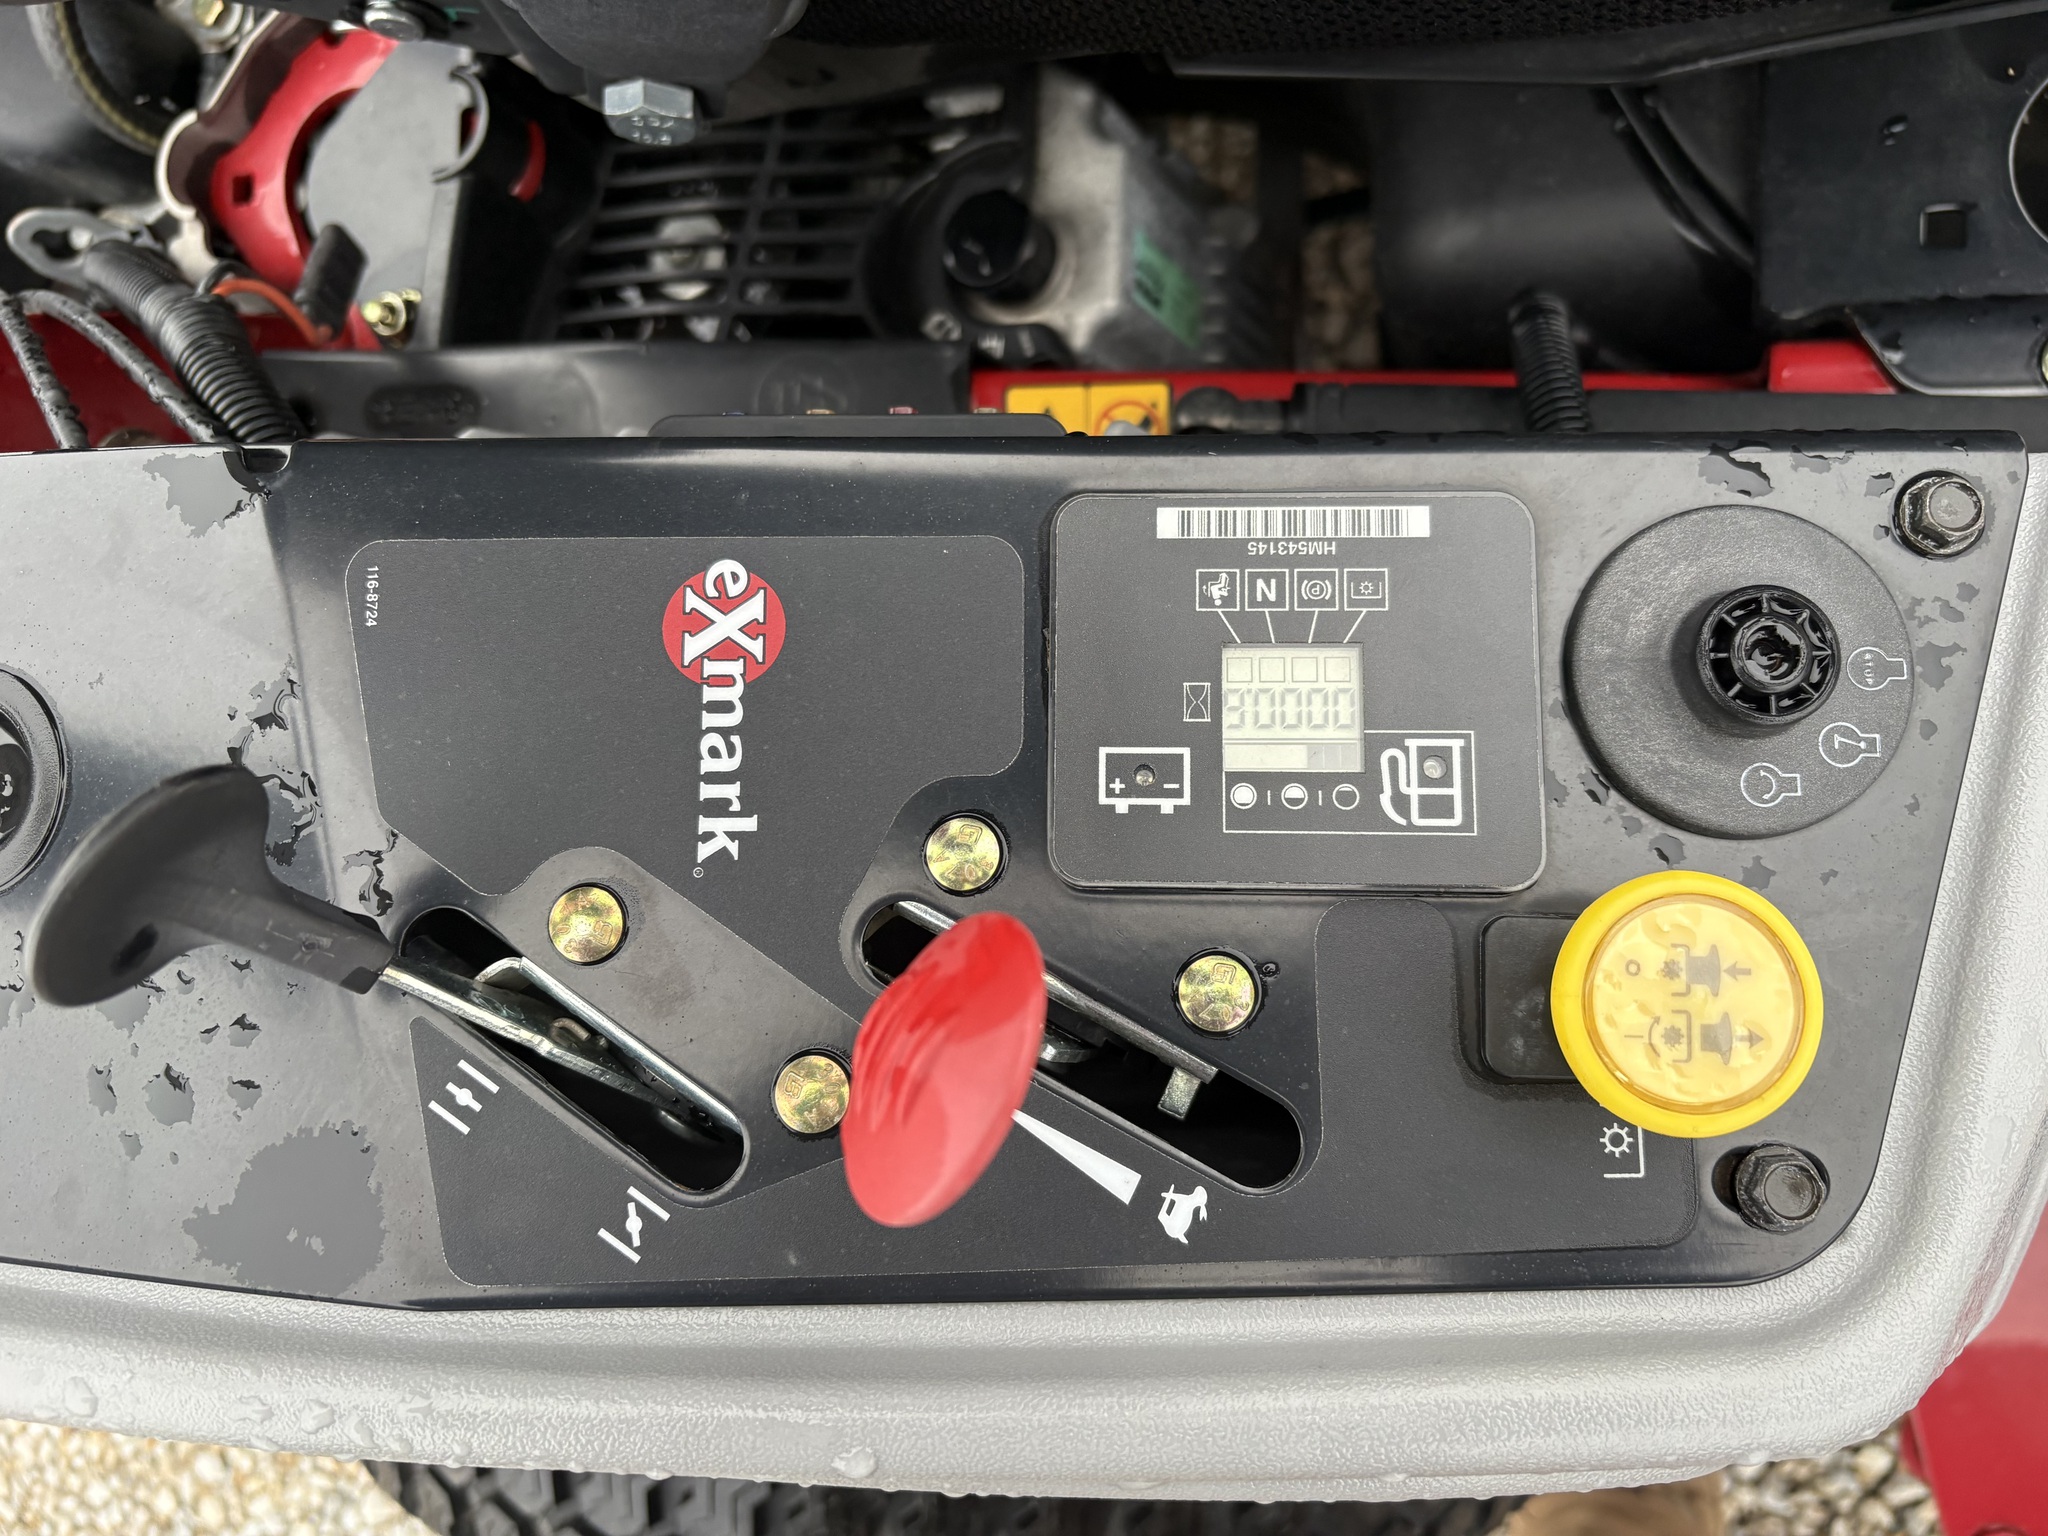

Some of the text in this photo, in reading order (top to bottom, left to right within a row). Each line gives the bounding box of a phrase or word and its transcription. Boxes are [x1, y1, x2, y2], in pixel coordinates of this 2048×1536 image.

[1247, 541, 1336, 555] HM543145
[365, 566, 380, 628] 116-8724
[1256, 578, 1276, 602] N
[682, 559, 766, 864] eXmark
